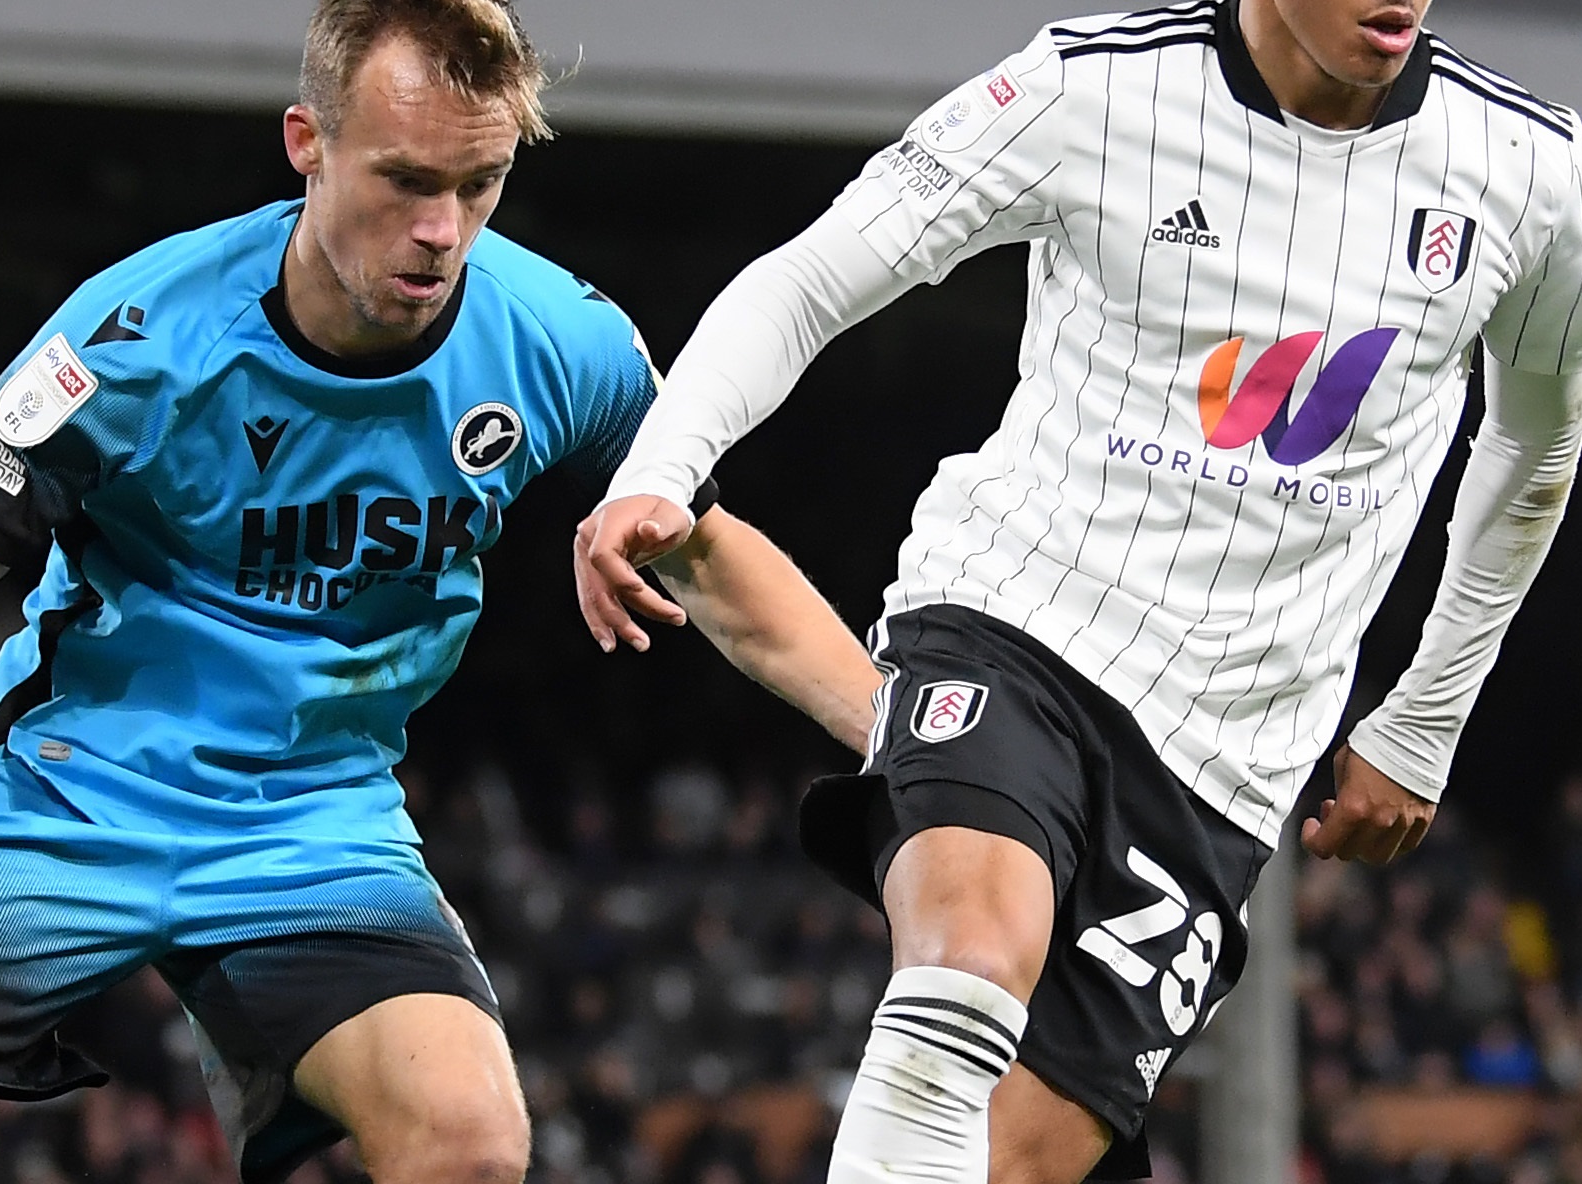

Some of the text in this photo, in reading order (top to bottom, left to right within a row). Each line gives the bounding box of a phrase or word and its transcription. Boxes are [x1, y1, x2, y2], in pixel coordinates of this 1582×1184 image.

[990, 75, 1013, 104] bet
[928, 120, 945, 142] EFL
[905, 143, 954, 189] TODAY
[906, 175, 938, 201] DAY
[1151, 227, 1221, 249] adidas
[45, 347, 82, 394] sky bet
[4, 411, 22, 434] EFL
[1107, 433, 1384, 510] WORLD MOBIL
[239, 494, 498, 573] HUSK
[1076, 846, 1222, 1036] 28
